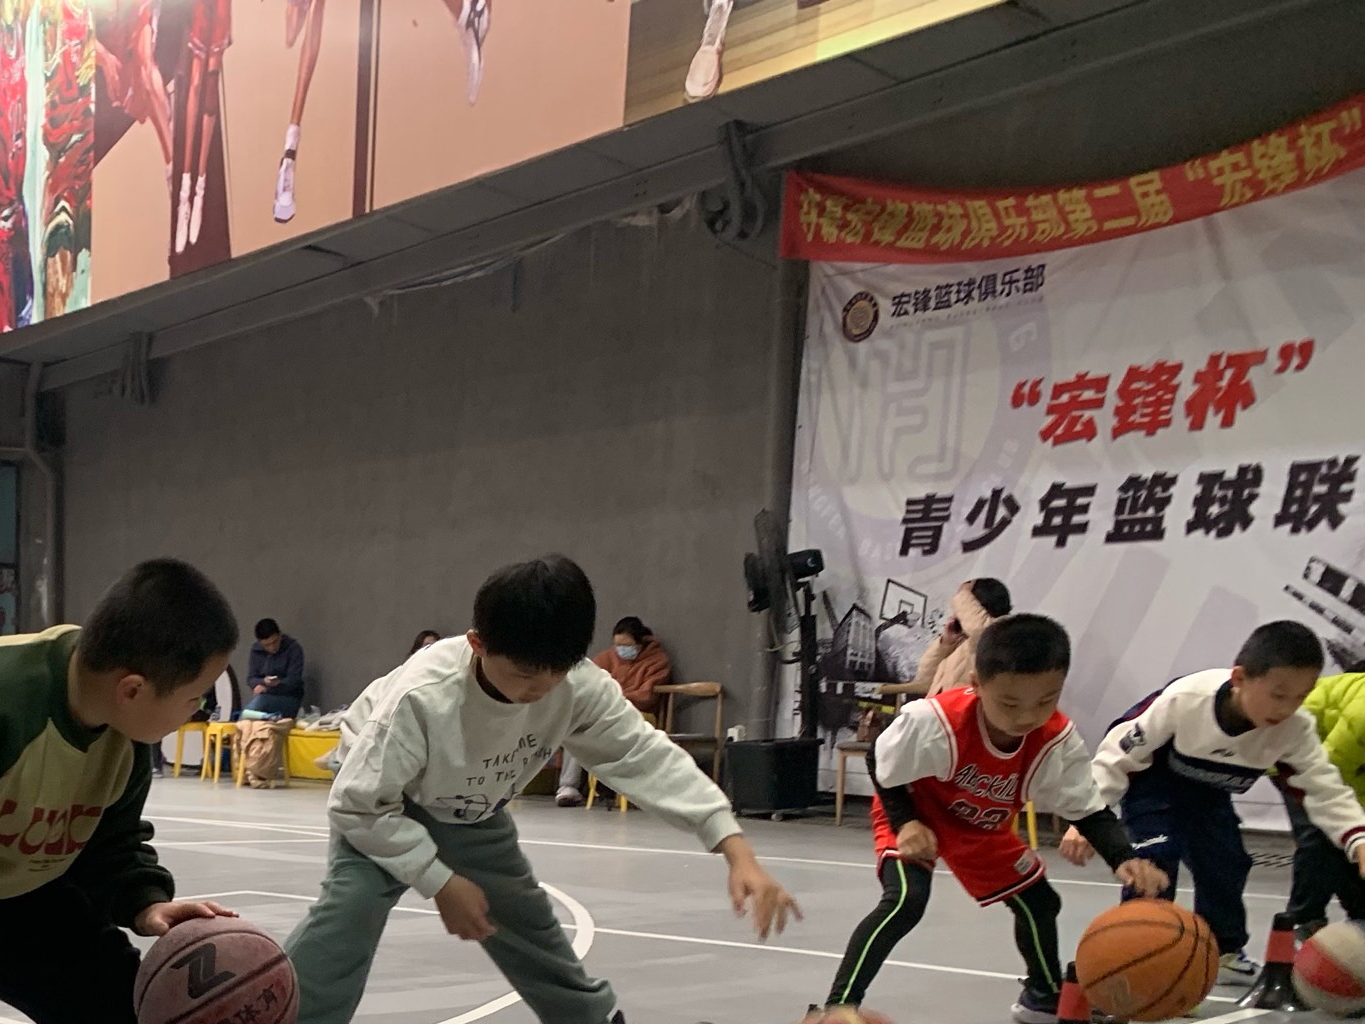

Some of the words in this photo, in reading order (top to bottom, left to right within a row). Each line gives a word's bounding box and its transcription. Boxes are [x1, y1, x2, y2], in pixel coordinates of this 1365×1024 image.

[890, 263, 1047, 319] 宏锋篮球俱乐部
[1011, 338, 1315, 447] “宏锋杯”
[898, 453, 1361, 558] 青少年篮球联
[466, 776, 485, 787] TO
